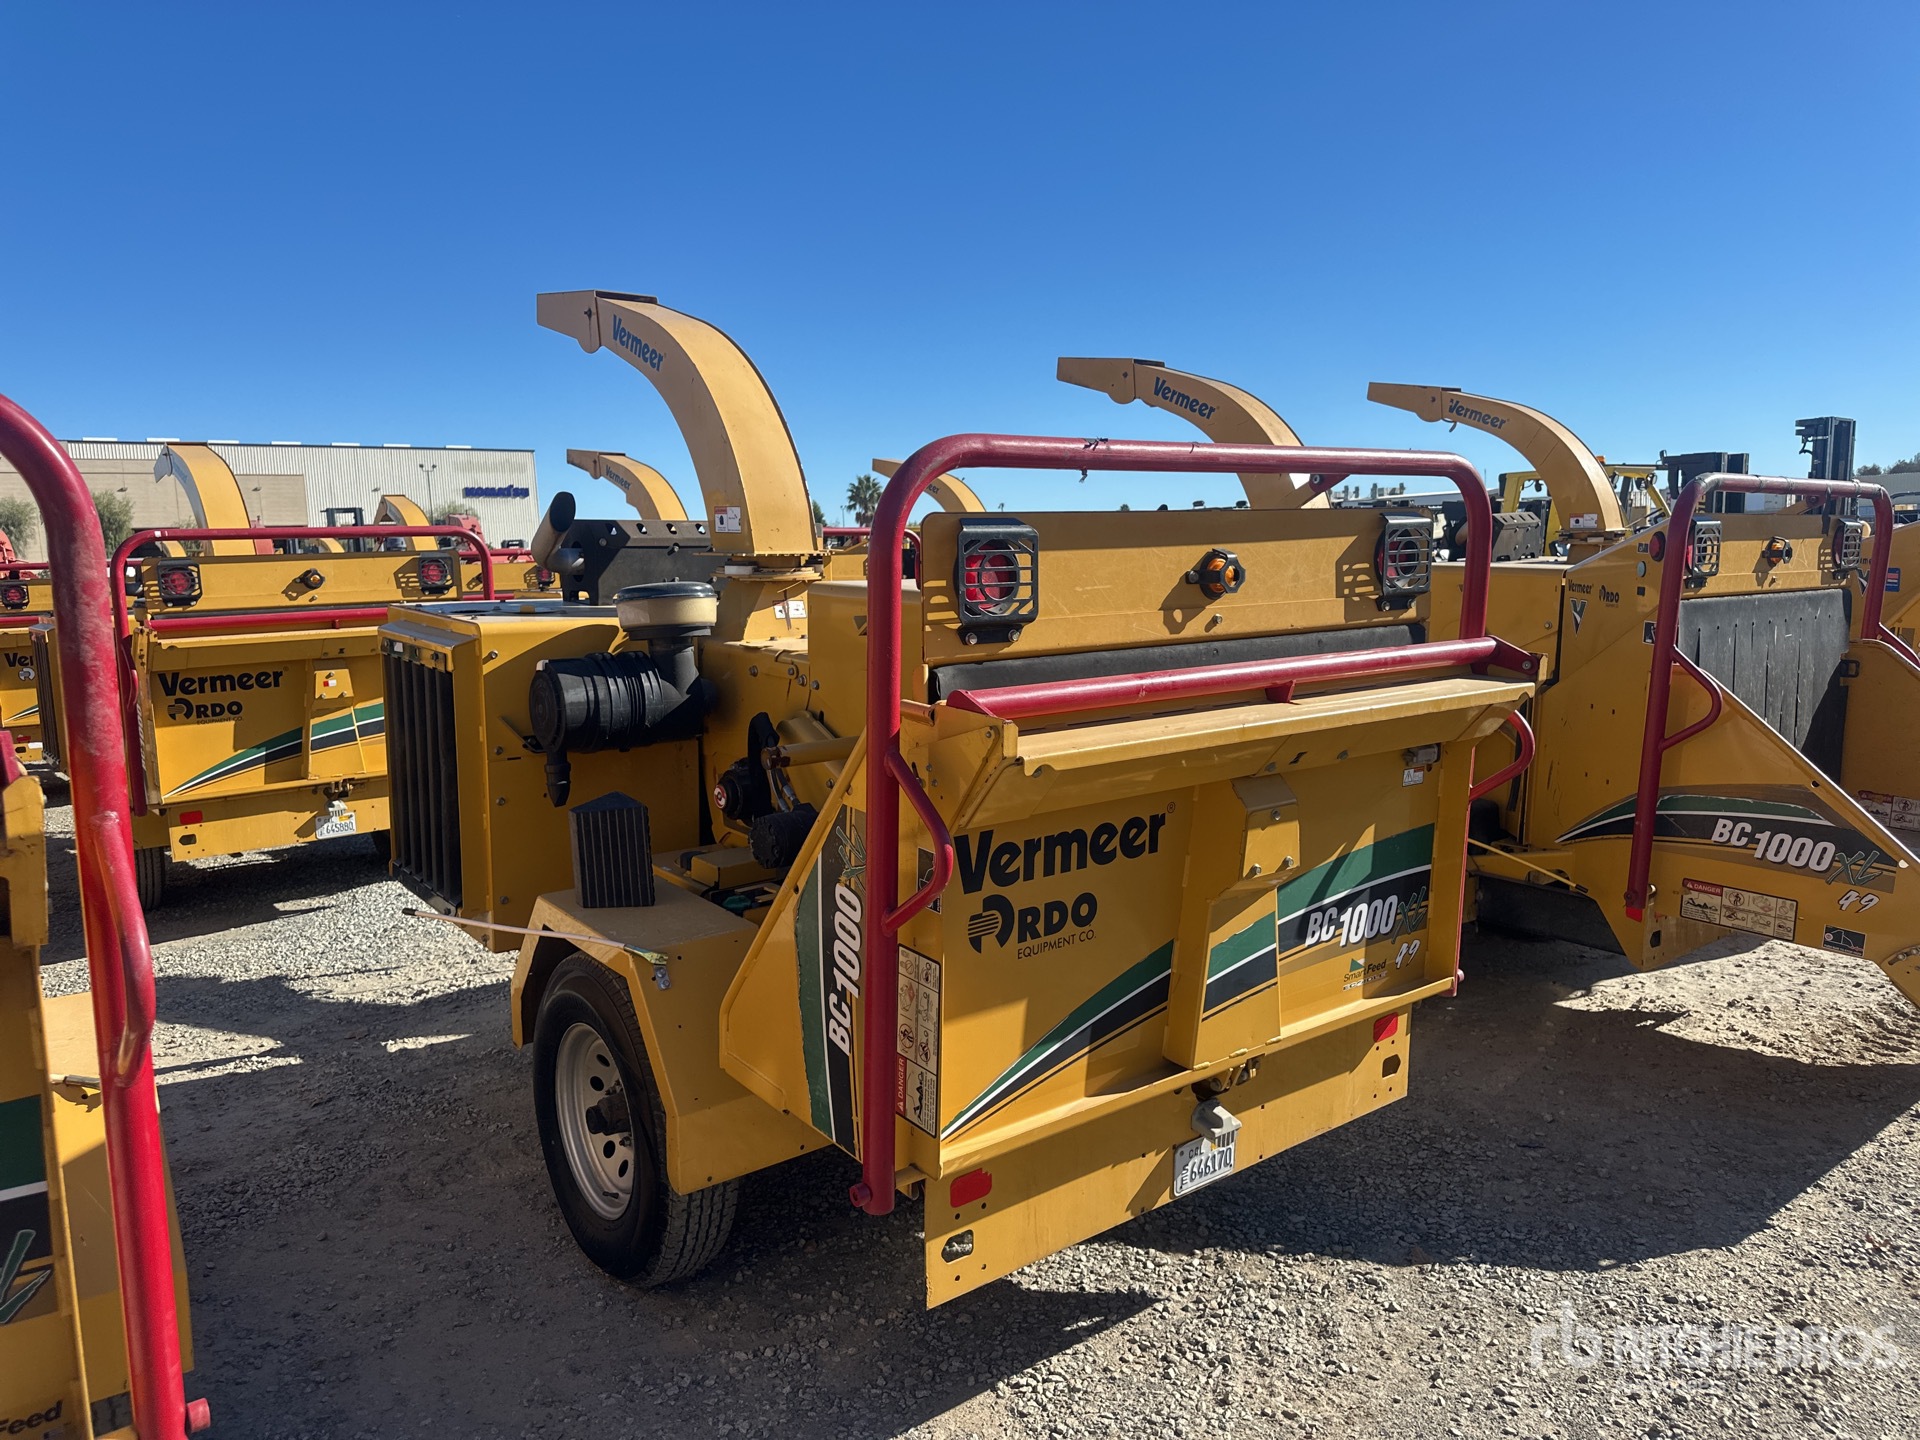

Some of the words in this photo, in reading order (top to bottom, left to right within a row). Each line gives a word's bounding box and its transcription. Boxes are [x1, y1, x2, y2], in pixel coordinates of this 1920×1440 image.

[613, 313, 664, 372] Vermeer
[1153, 376, 1216, 420] Vermeer
[1448, 398, 1507, 430] Vermeer
[463, 484, 530, 498] KOMATSU
[1568, 579, 1592, 595] Vermeer
[157, 670, 284, 697] Vermeer
[953, 812, 1166, 895] Vermeer
[1693, 883, 1721, 894] DANGER
[1838, 889, 1880, 914] 49
[1017, 933, 1077, 960] EQUIPMENT
[1190, 1147, 1232, 1183] 646170
